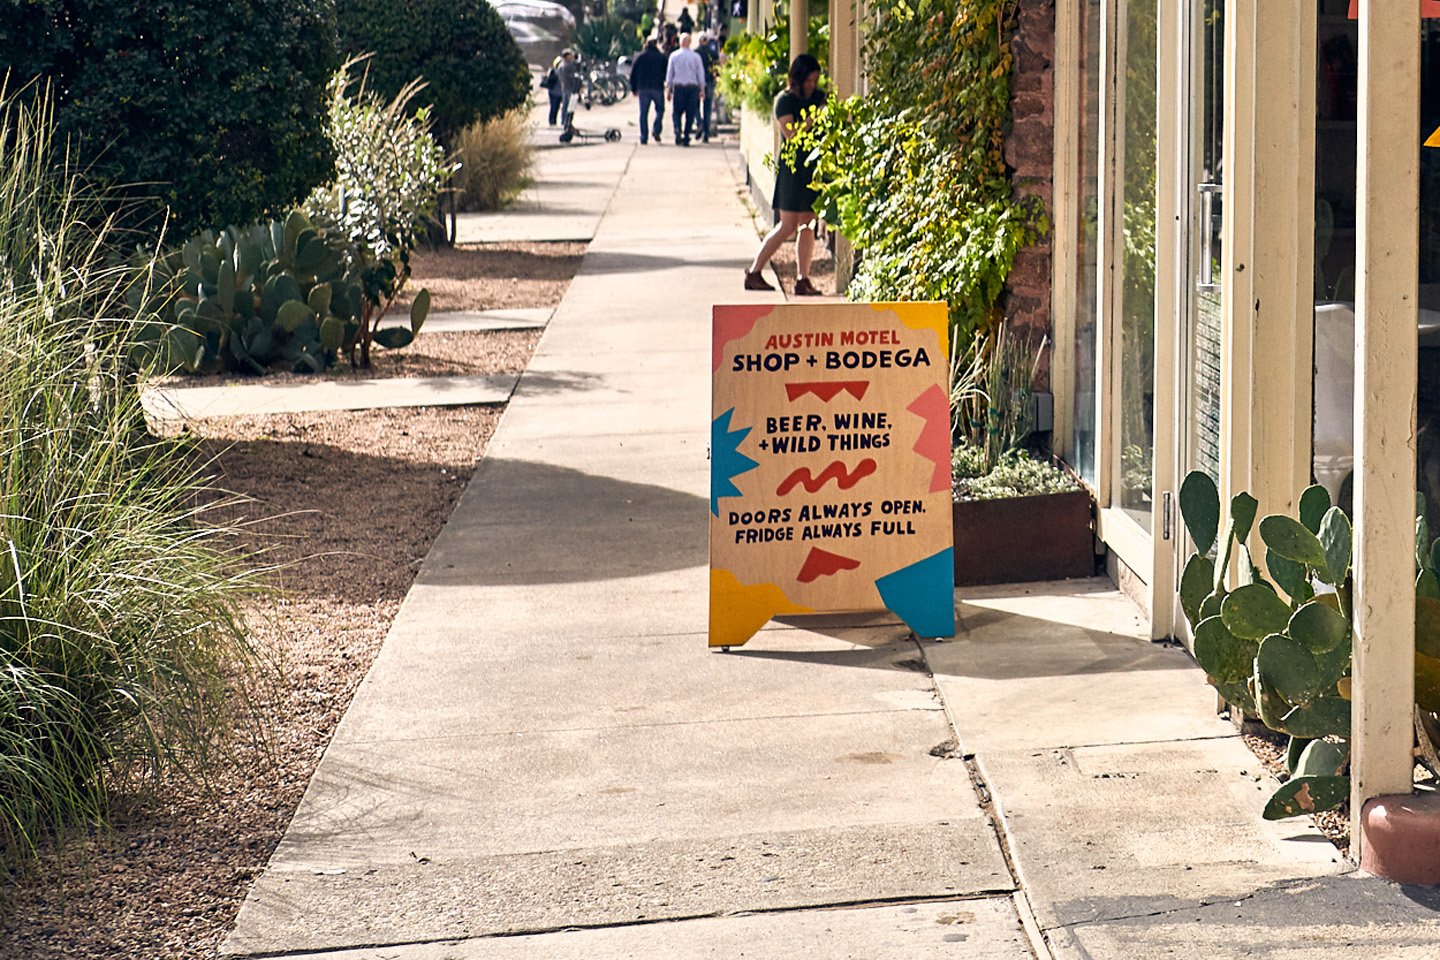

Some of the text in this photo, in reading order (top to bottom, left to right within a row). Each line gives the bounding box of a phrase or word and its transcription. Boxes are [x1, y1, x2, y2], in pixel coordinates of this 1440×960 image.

[764, 330, 901, 350] AUSTIN MOTEL
[732, 348, 931, 372] SHOP + BODEGA
[827, 433, 891, 451] THINGS
[729, 508, 792, 526] DOORS
[798, 501, 873, 522] ALWAYS
[735, 521, 916, 544] FRIDGE ALWAYS FULL
